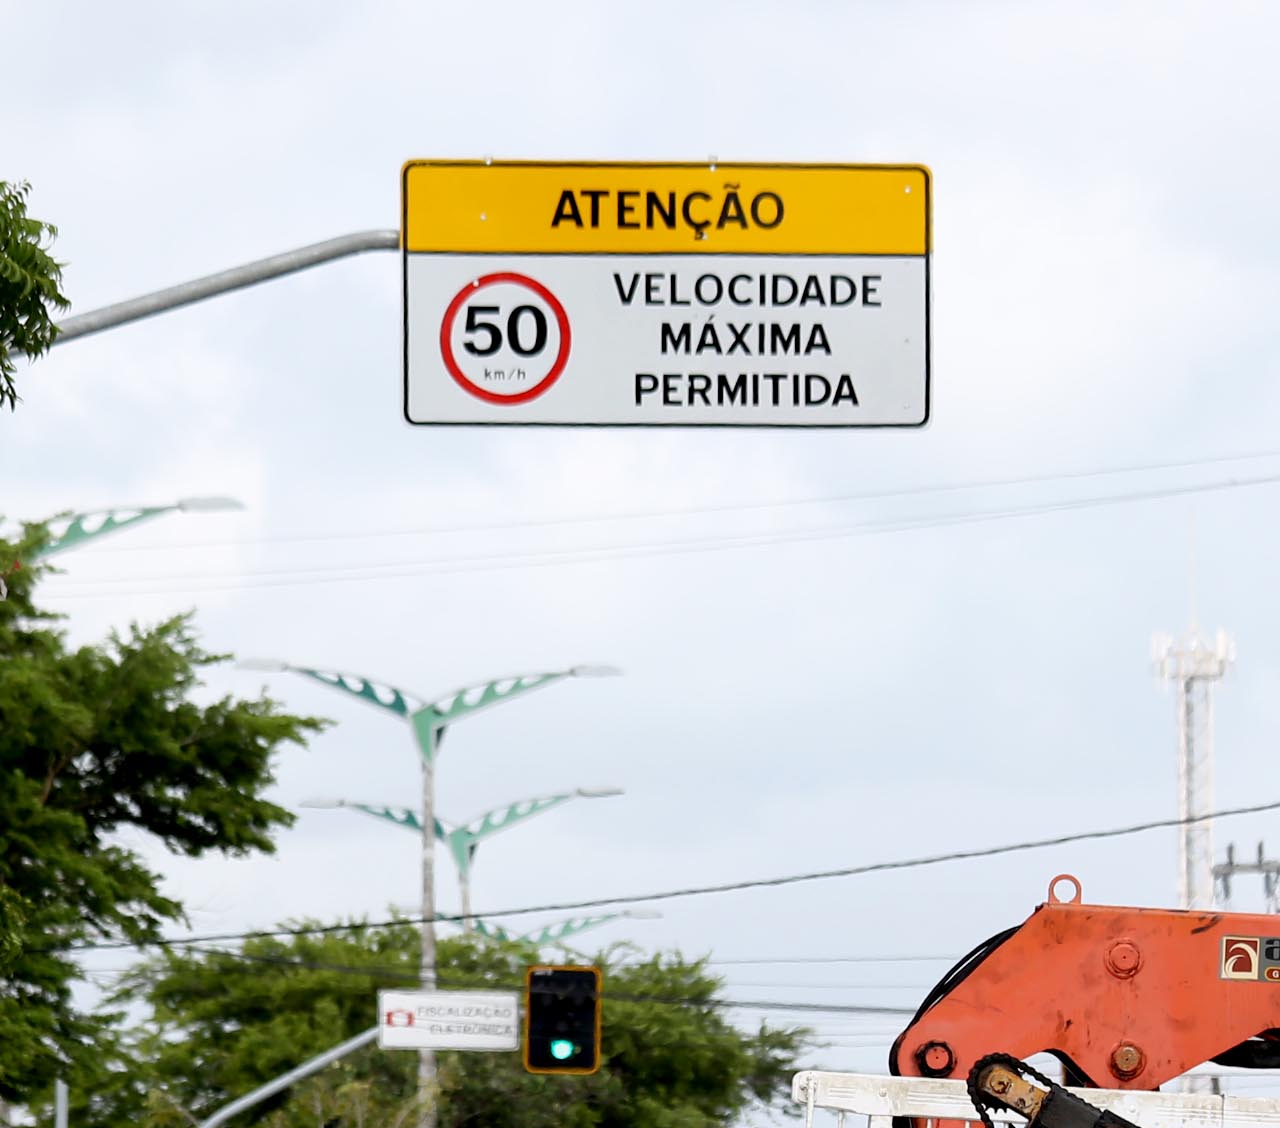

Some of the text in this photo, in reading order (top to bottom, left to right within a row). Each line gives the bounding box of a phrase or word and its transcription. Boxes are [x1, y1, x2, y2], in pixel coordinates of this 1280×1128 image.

[551, 183, 785, 240] ATENÇÃO
[613, 273, 883, 308] VELOCIDADE
[463, 304, 549, 359] 50
[660, 315, 832, 356] MÁXIMA
[484, 366, 527, 382] km/h
[635, 373, 860, 407] PERMITIDA
